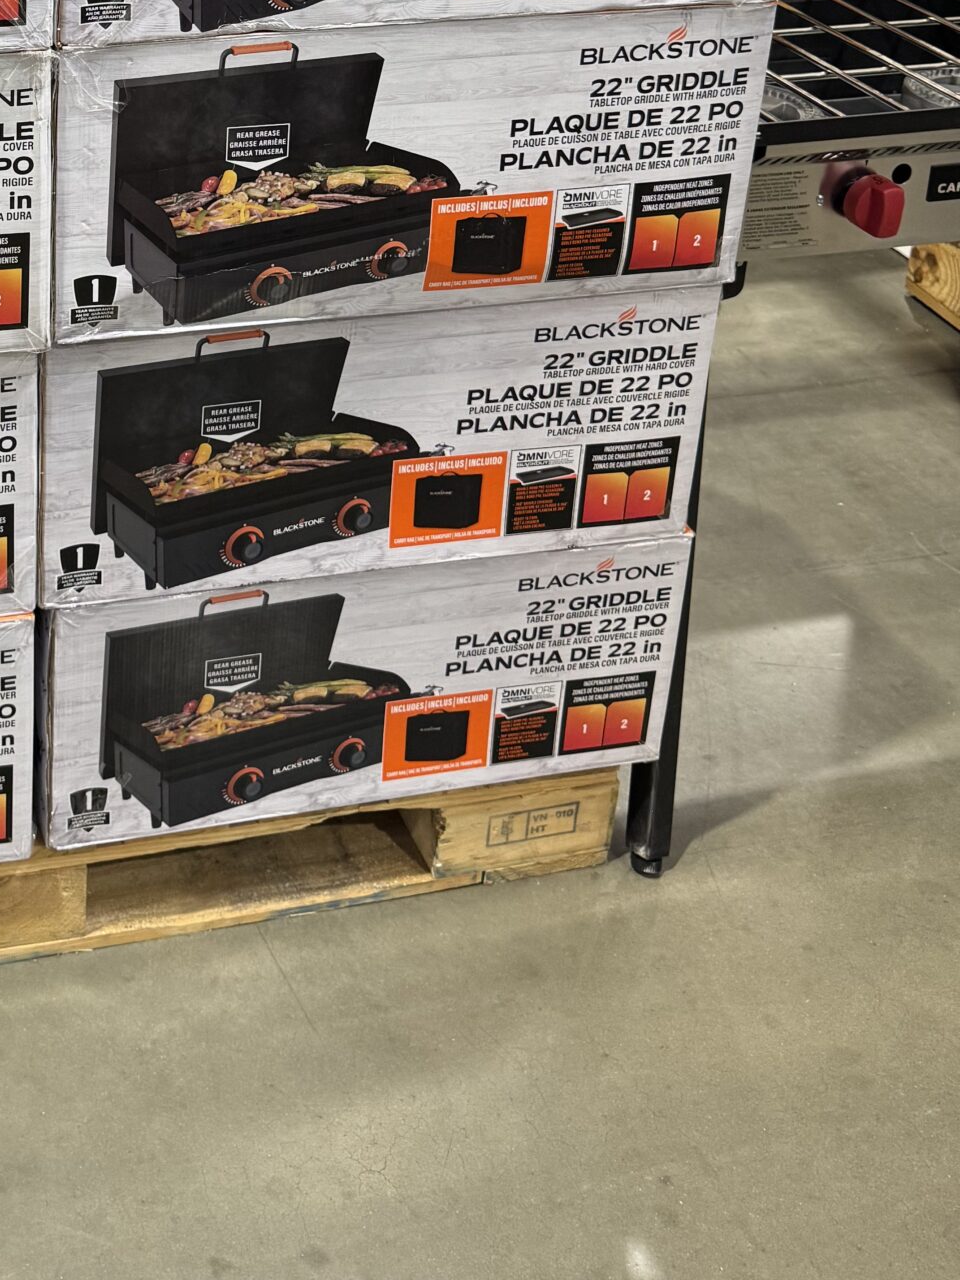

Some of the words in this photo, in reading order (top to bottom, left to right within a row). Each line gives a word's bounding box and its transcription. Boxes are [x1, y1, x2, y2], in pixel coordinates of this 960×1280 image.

[590, 77, 633, 98] 22"
[637, 67, 750, 94] GRIDDLE
[510, 111, 620, 137] PLAQUE
[627, 108, 663, 128] DE
[669, 105, 701, 125] 22
[708, 100, 744, 121] PO
[499, 144, 631, 172] PLANCHA
[638, 140, 674, 160] DE
[680, 136, 711, 156] 22
[718, 134, 737, 152] in
[10, 191, 32, 210] in
[543, 352, 585, 370] 22"
[588, 342, 698, 367] GRIDDLE
[467, 382, 573, 405] PLAQUE
[579, 378, 614, 396] DE
[620, 376, 650, 393] 22
[658, 372, 693, 390] PO
[456, 410, 582, 435] PLANCHA
[590, 406, 624, 424] DE
[630, 403, 660, 421] 22
[667, 402, 686, 417] in
[527, 598, 565, 616] 22"
[569, 587, 672, 611] GRIDDLE
[455, 625, 554, 650] PLAQUE
[560, 621, 592, 638] DE
[598, 617, 626, 634] 22
[633, 613, 667, 630] PO
[445, 650, 563, 677] PLANCHA
[570, 645, 602, 662] DE
[608, 641, 636, 658] 22
[643, 640, 661, 654] in
[530, 824, 547, 834] HT
